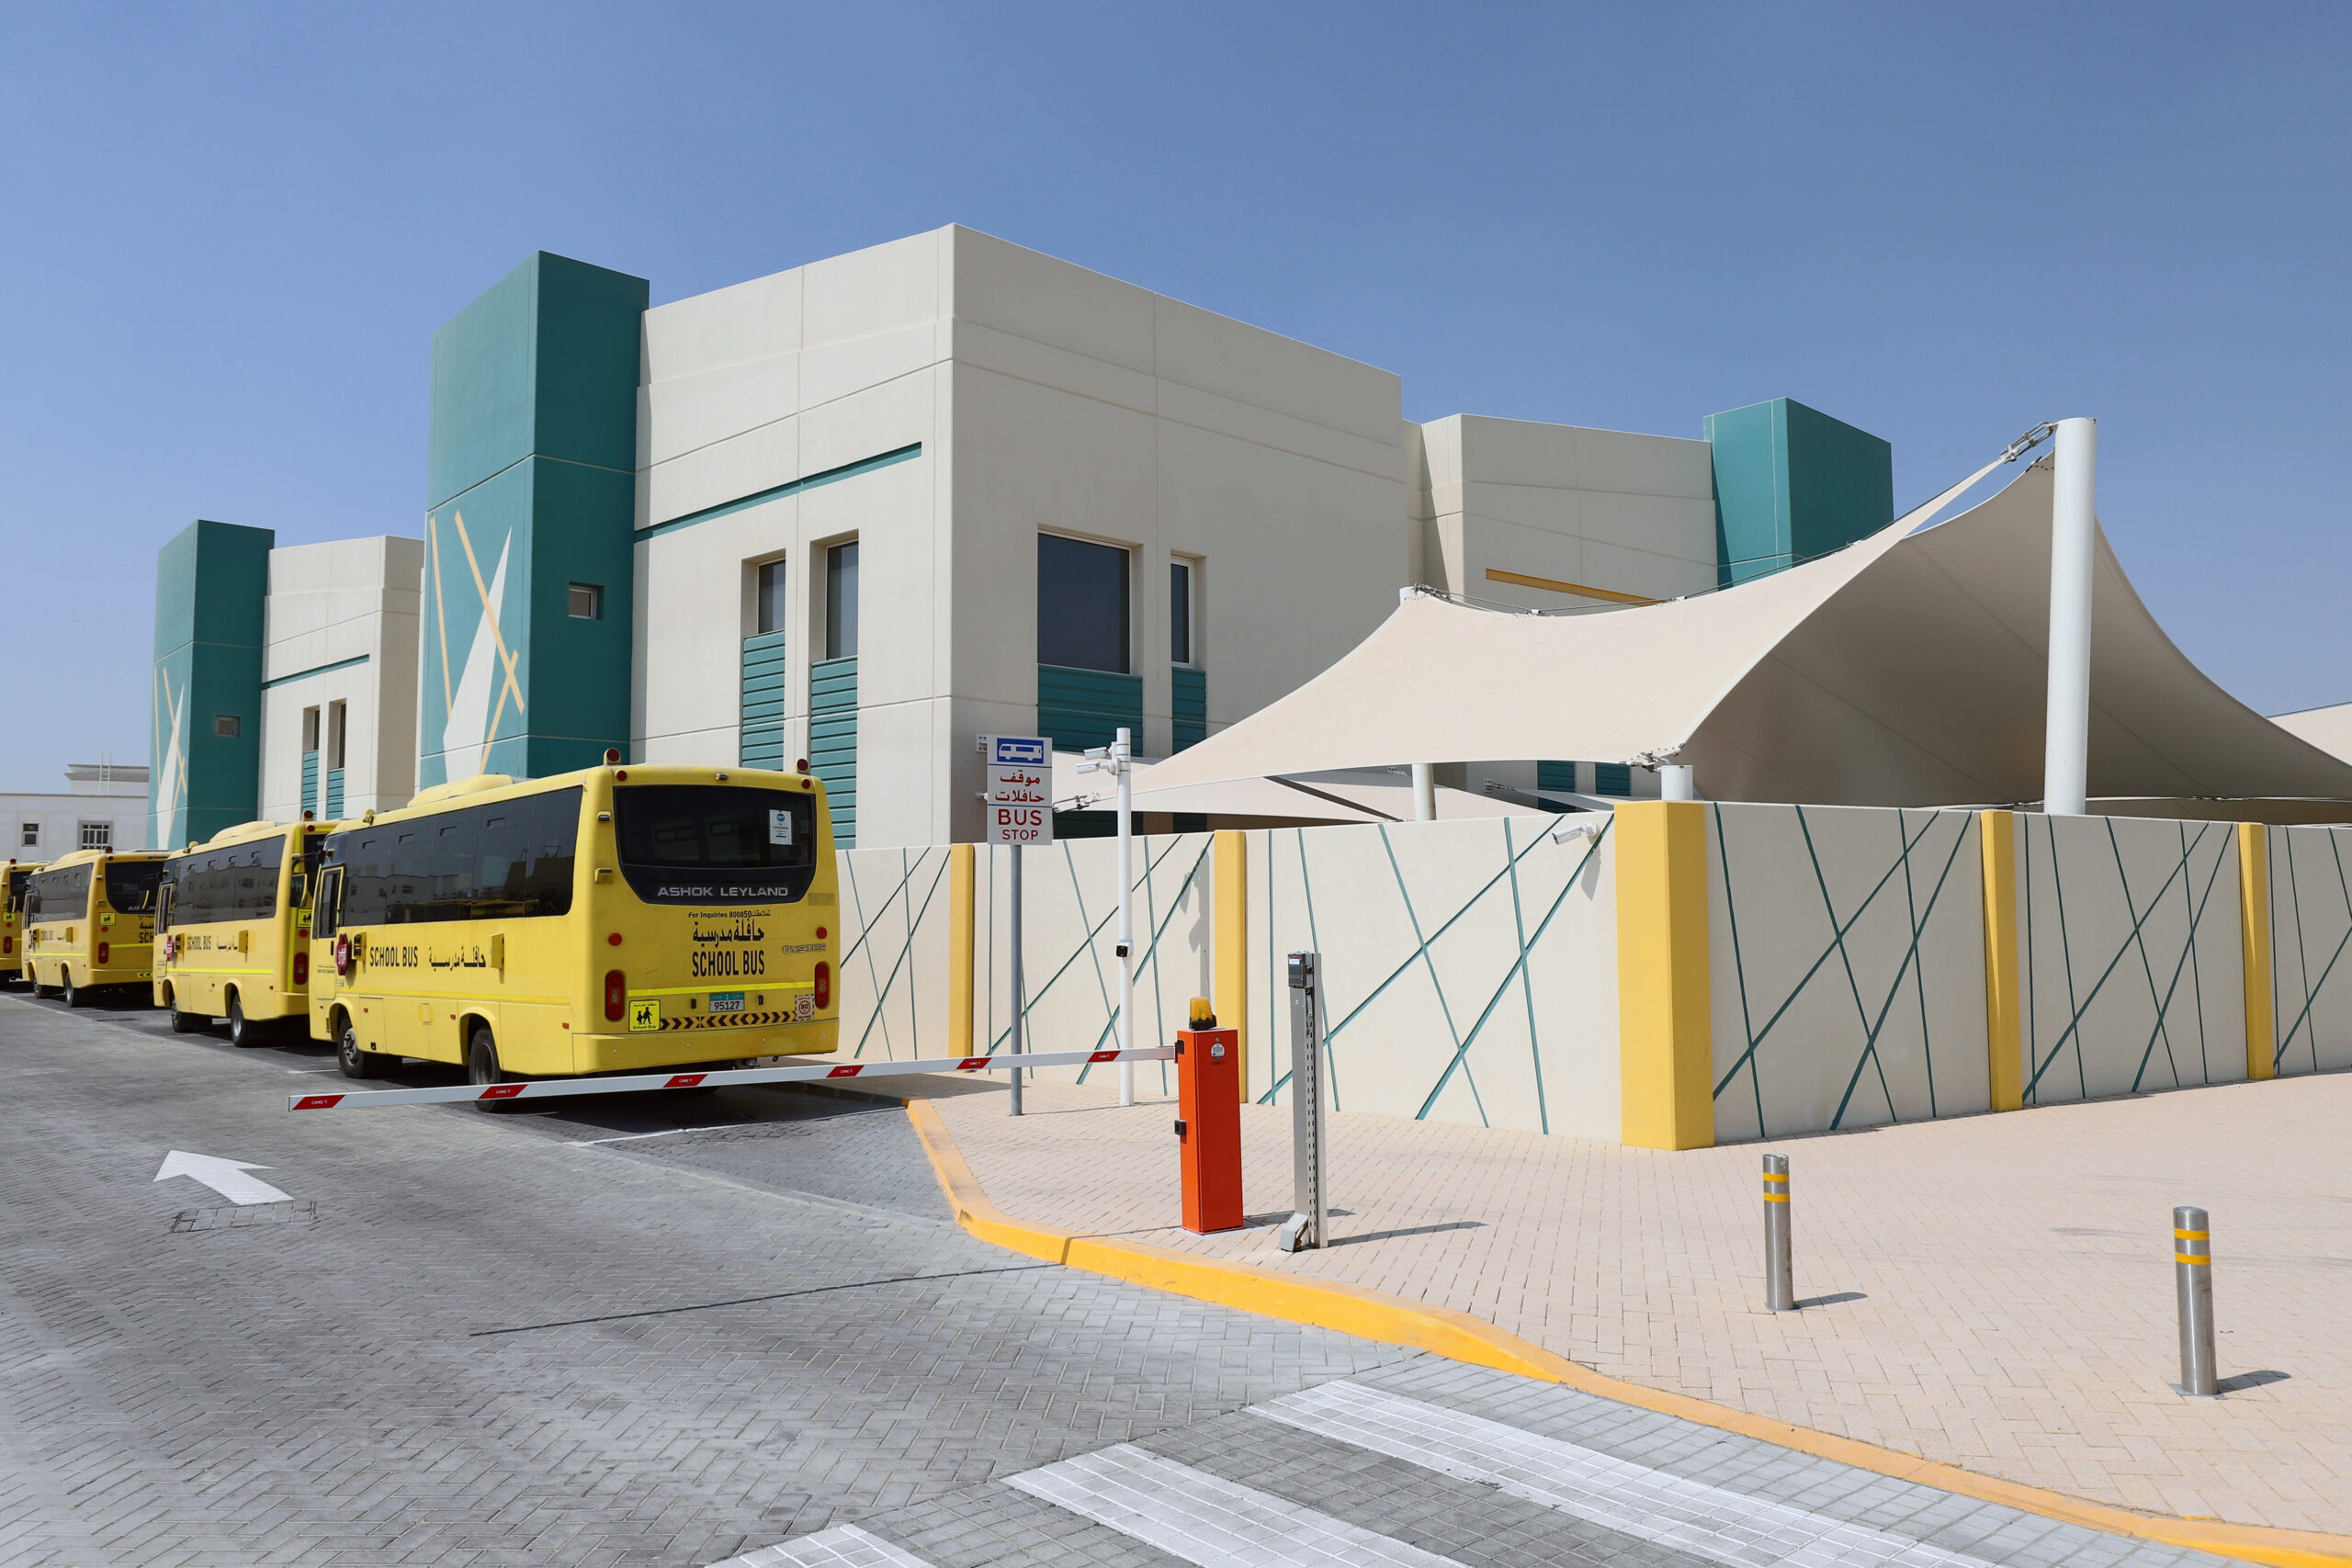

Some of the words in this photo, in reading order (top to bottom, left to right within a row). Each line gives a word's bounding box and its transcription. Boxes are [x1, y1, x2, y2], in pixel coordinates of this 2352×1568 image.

[1000, 770, 1040, 787] موقف
[995, 790, 1045, 803] حافلات
[998, 808, 1043, 826] BUS
[1002, 829, 1038, 840] STOP
[657, 887, 713, 897] ASHOK
[720, 886, 788, 897] LEYLAND
[140, 932, 154, 943] SCH
[693, 921, 732, 948] مدرسية
[734, 918, 764, 942] حافلة
[370, 946, 400, 967] SCHOOL
[402, 946, 418, 967] BUS
[461, 944, 486, 967] حافلة
[783, 943, 827, 953] OYSTER
[429, 946, 460, 971] مدرسية
[692, 951, 739, 977] SCHOOL
[742, 950, 764, 976] BUS
[714, 1000, 740, 1010] 95127
